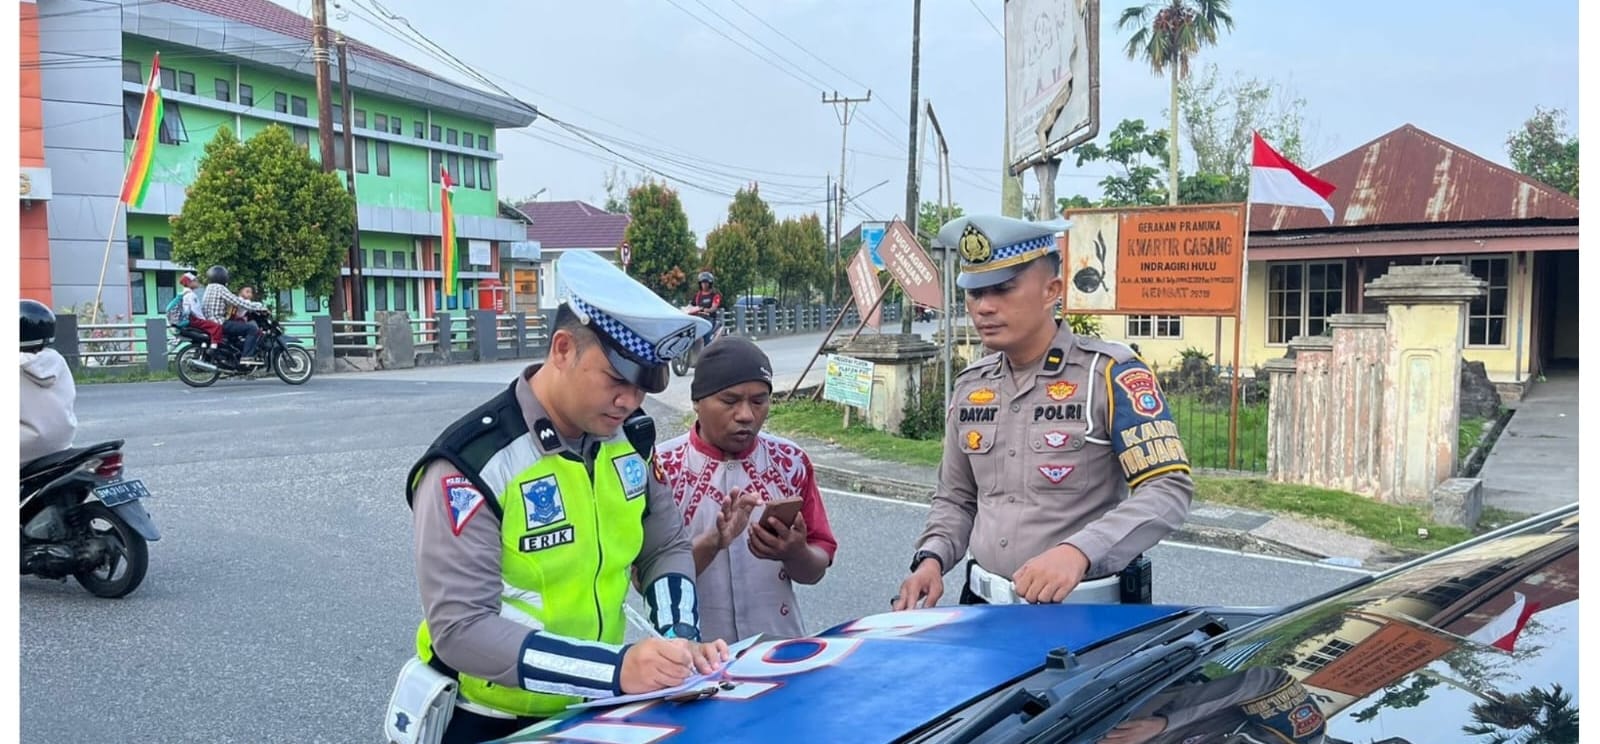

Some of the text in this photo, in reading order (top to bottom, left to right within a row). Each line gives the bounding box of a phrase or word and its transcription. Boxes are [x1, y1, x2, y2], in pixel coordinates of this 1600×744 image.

[1138, 220, 1221, 233] GERAKAN PRAMUKA
[1127, 236, 1232, 257] KWARTIR CABANG
[892, 228, 933, 283] TUGU AGRESI
[895, 251, 923, 286] JANUARI
[1140, 261, 1217, 271] INDRAGIRI HULU
[959, 407, 998, 422] DAYAT
[1033, 404, 1082, 421] POLRI
[528, 531, 568, 549] ERIK
